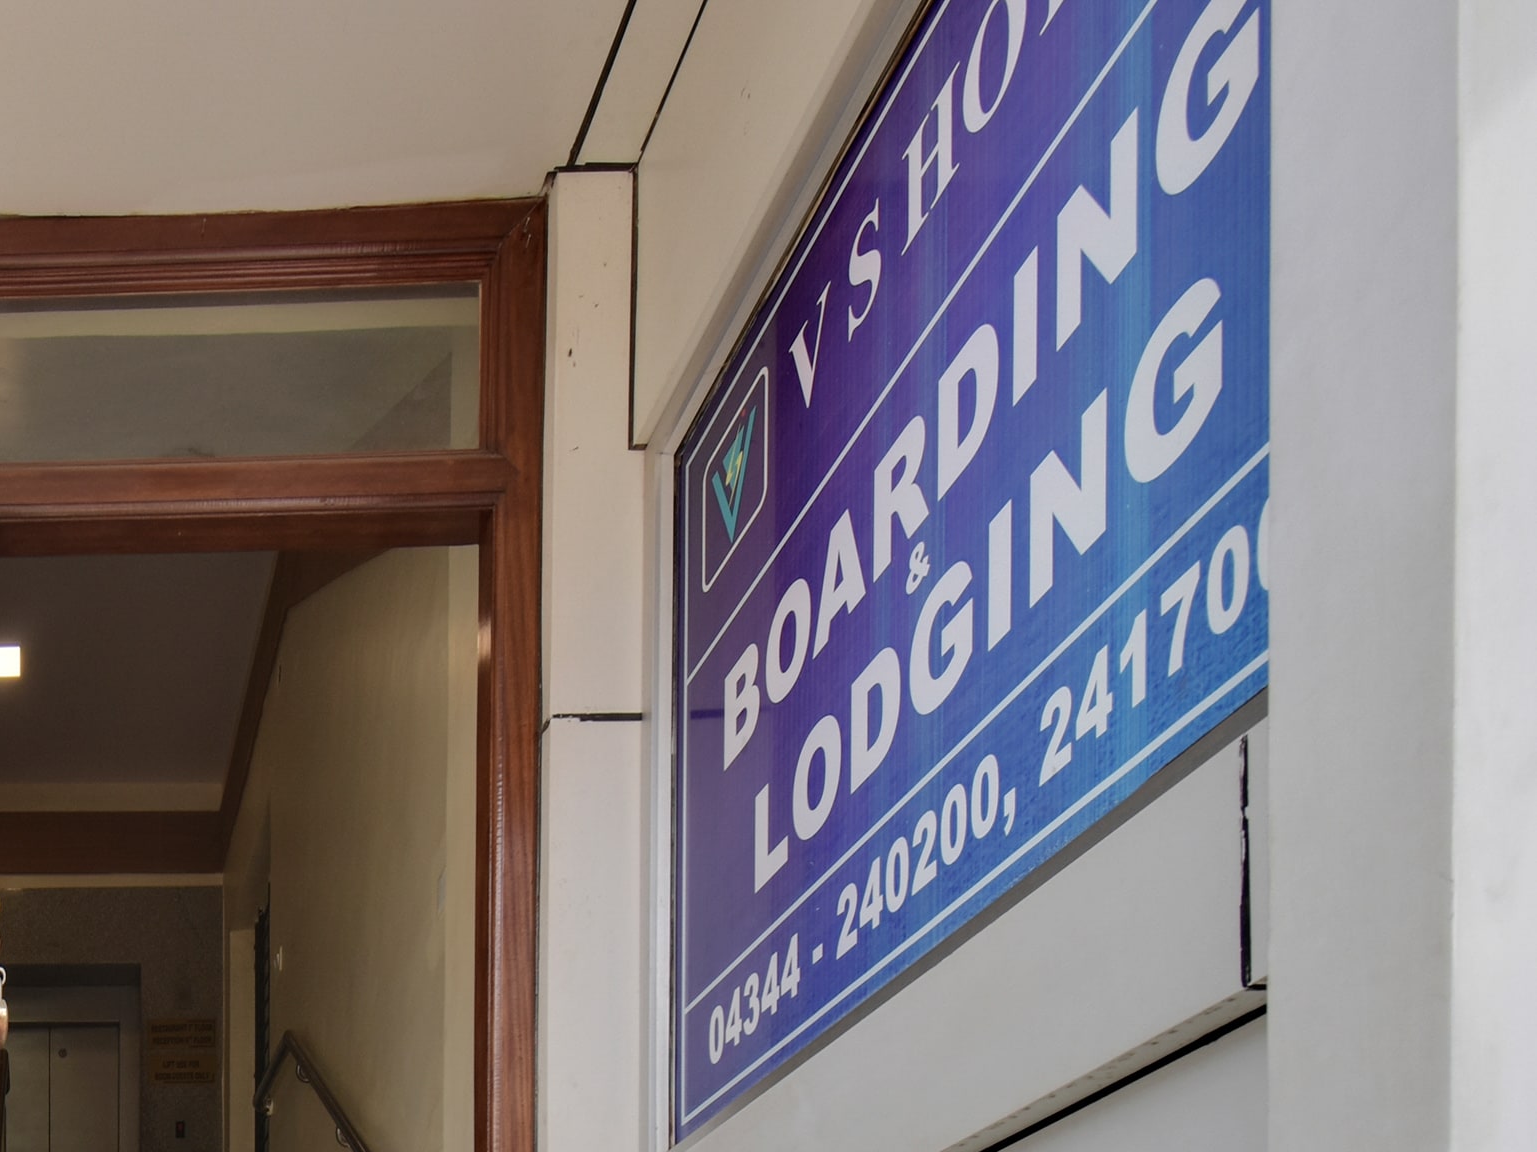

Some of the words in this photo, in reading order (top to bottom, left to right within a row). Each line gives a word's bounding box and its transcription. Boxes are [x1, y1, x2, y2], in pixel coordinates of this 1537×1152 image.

[901, 0, 1063, 256] HO
[723, 0, 1260, 772] BOARDING
[754, 277, 1224, 894] LODGING
[906, 541, 931, 595] &
[708, 932, 801, 1065] 04344
[835, 753, 1016, 961] 240200,
